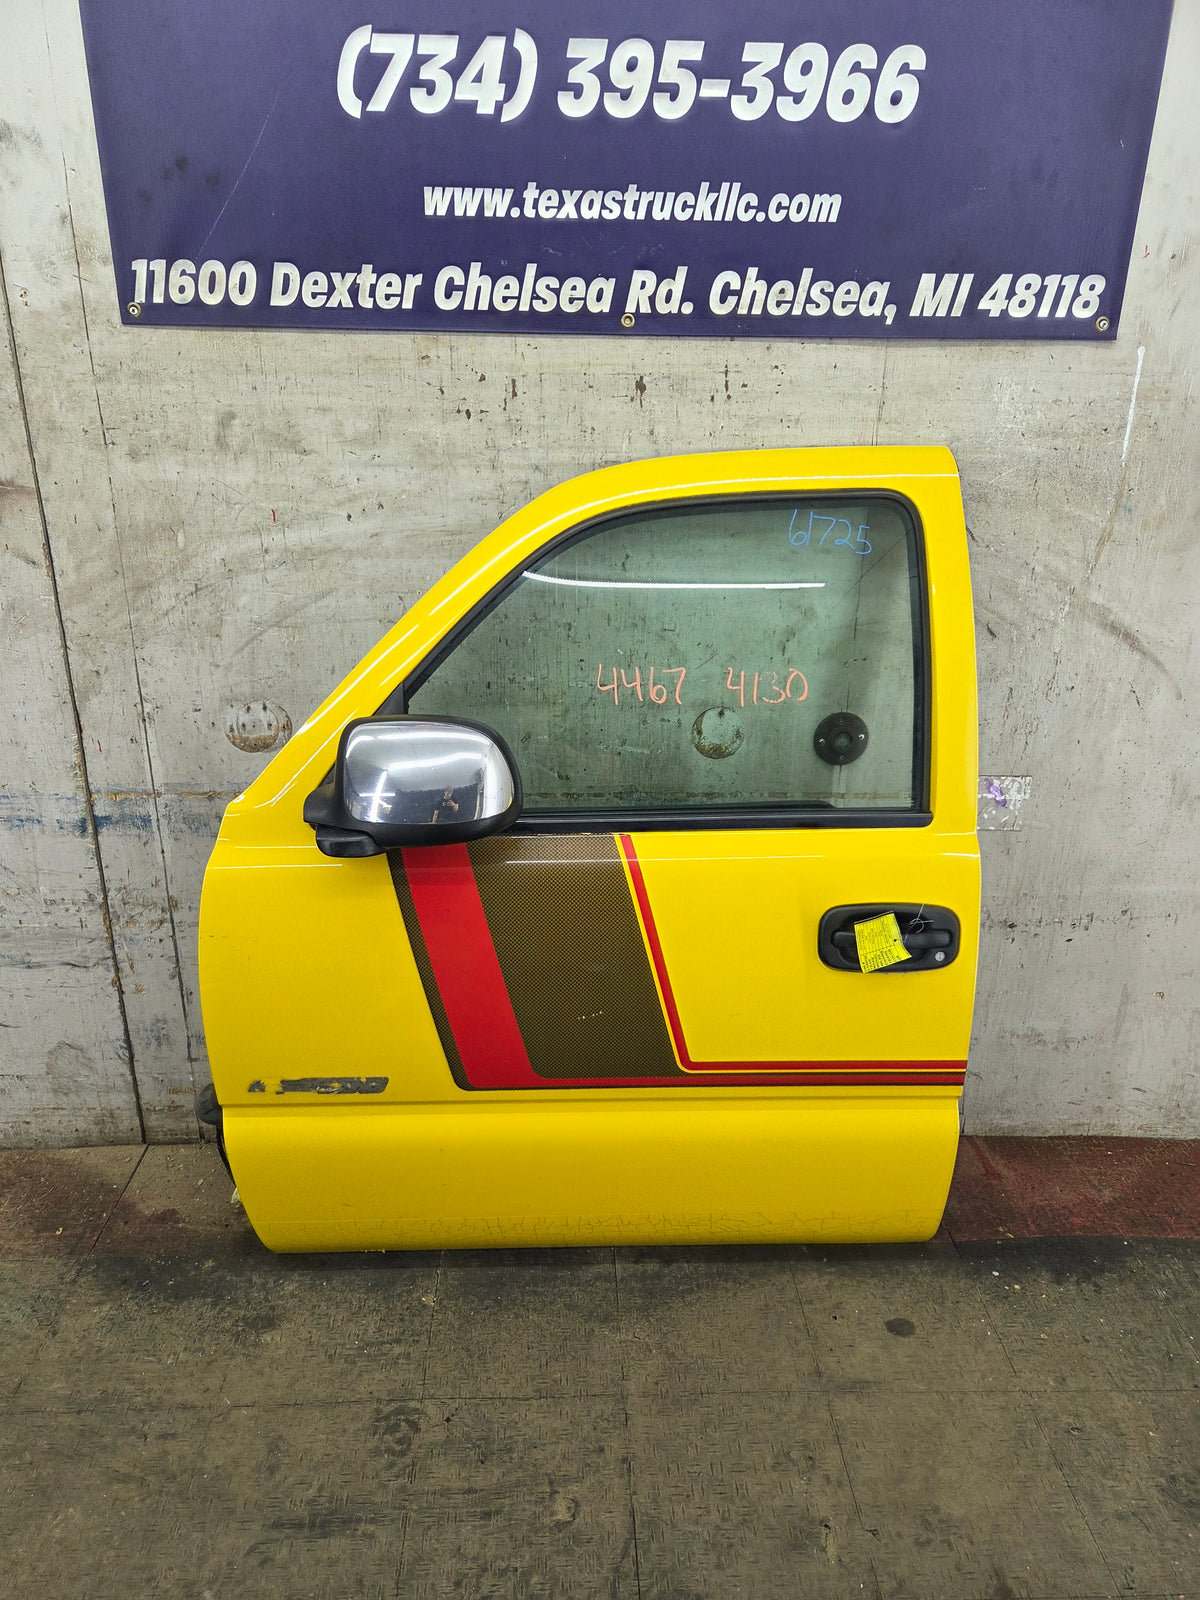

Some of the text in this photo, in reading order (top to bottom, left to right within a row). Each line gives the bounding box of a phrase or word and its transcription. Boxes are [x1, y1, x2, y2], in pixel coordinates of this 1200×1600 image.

[337, 24, 928, 125] (734) 395-3966
[423, 182, 842, 223] www.texastruckllc.com
[132, 259, 1106, 325] 11600 Dexter Chelsea Rd. Chelsea, MI 48118
[788, 508, 873, 555] 61725
[596, 663, 809, 708] 4467 4130
